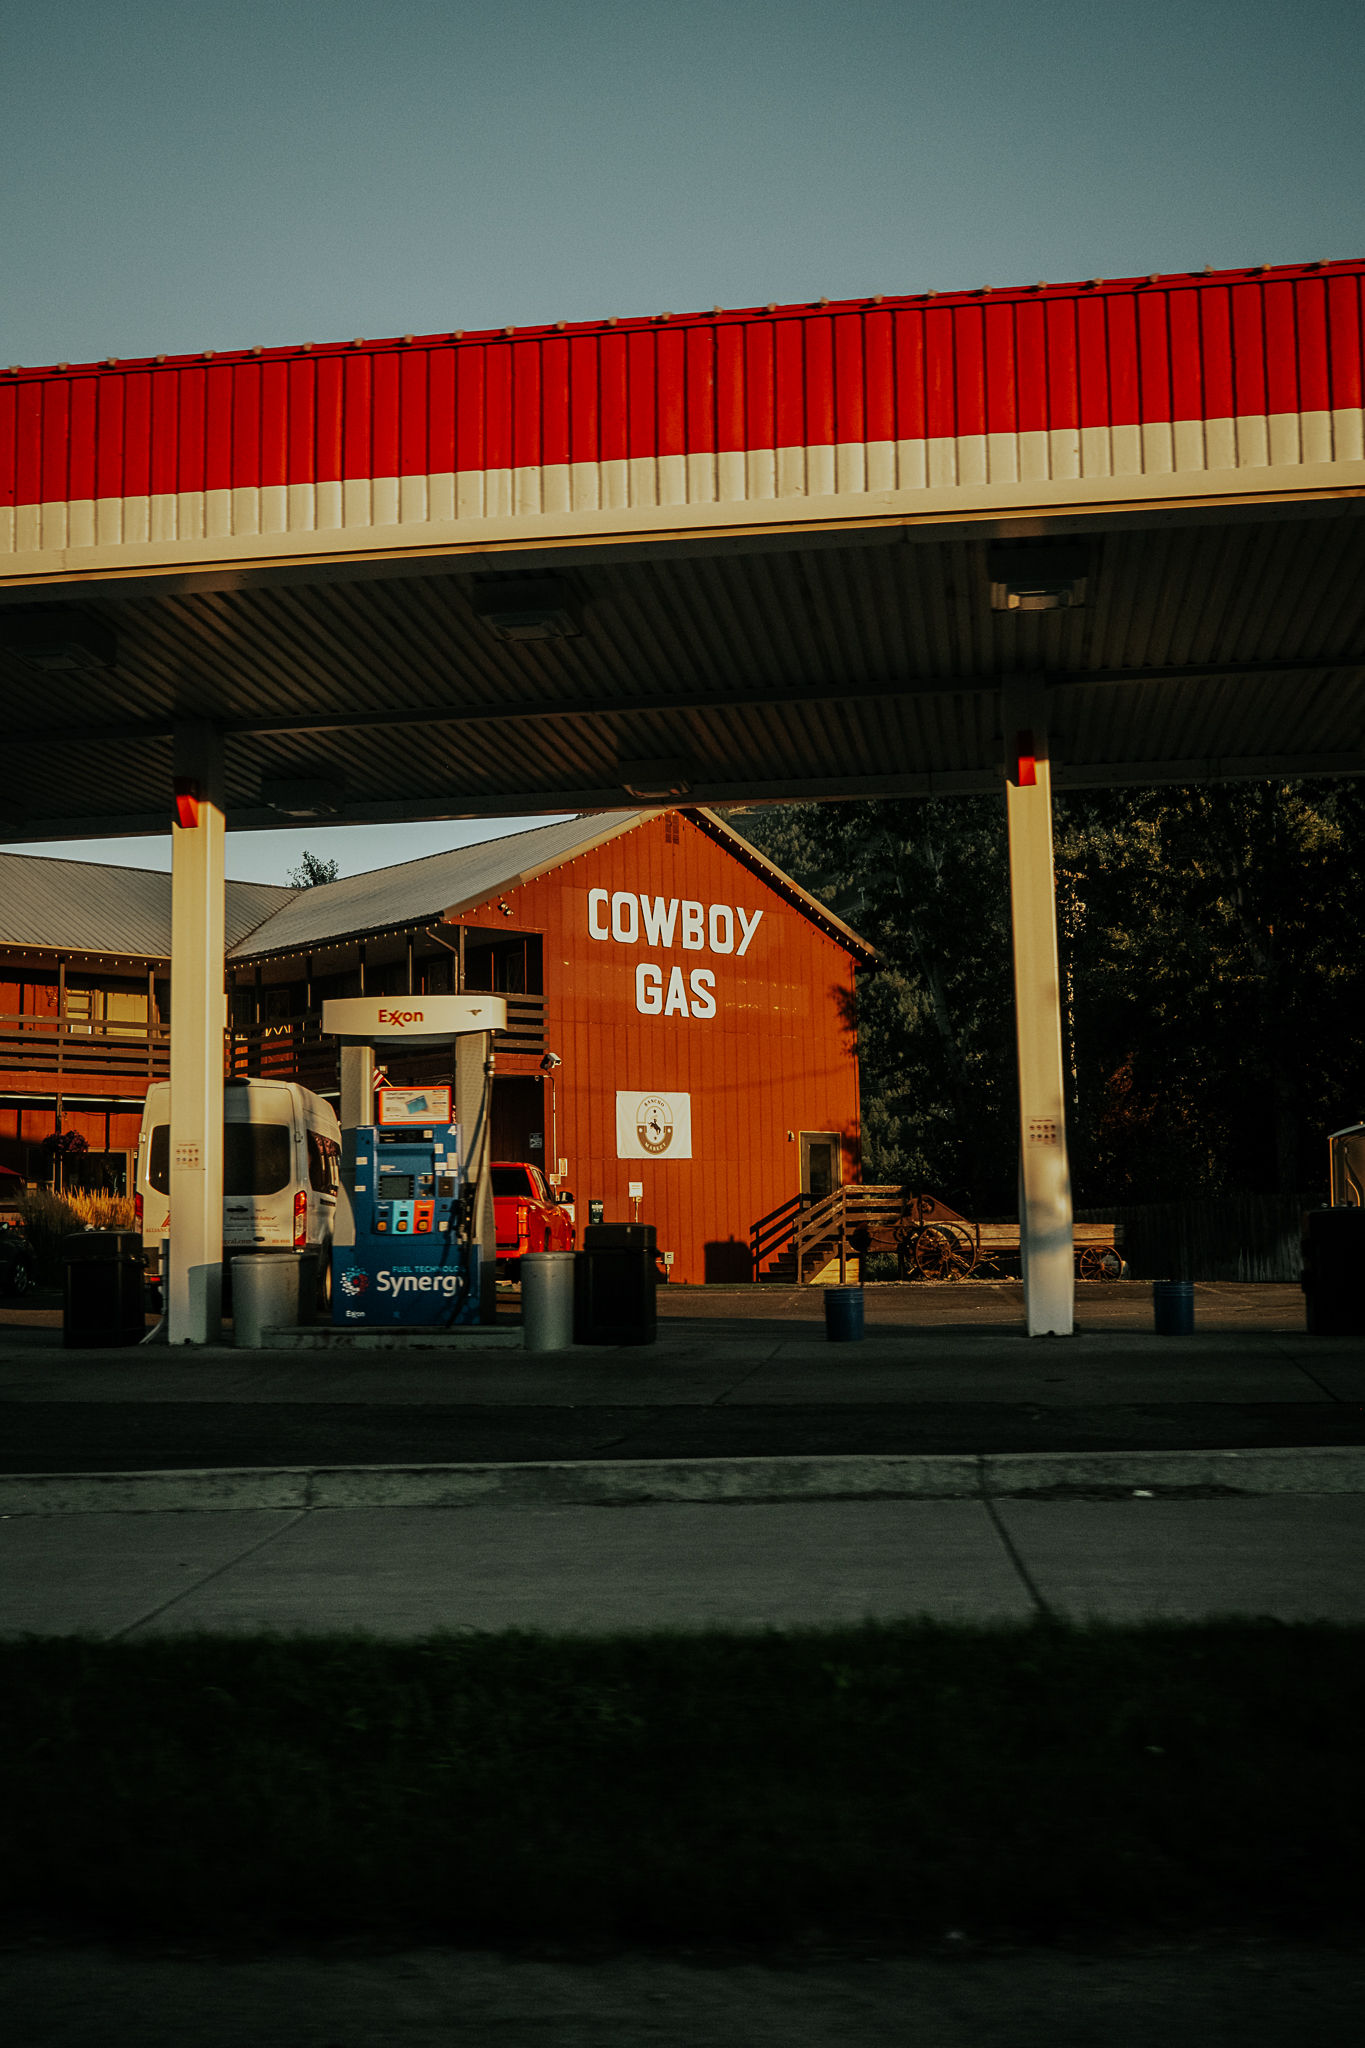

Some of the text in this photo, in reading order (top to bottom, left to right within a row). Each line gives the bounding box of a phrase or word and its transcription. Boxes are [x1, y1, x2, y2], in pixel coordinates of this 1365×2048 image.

[588, 887, 764, 956] COWBOY
[635, 962, 717, 1019] GAS
[378, 1009, 424, 1028] Exxon
[643, 1098, 665, 1107] RANCHO
[644, 1142, 667, 1152] MARKET
[392, 1265, 466, 1273] FUEL TECHOLO
[345, 1310, 366, 1319] Exxon
